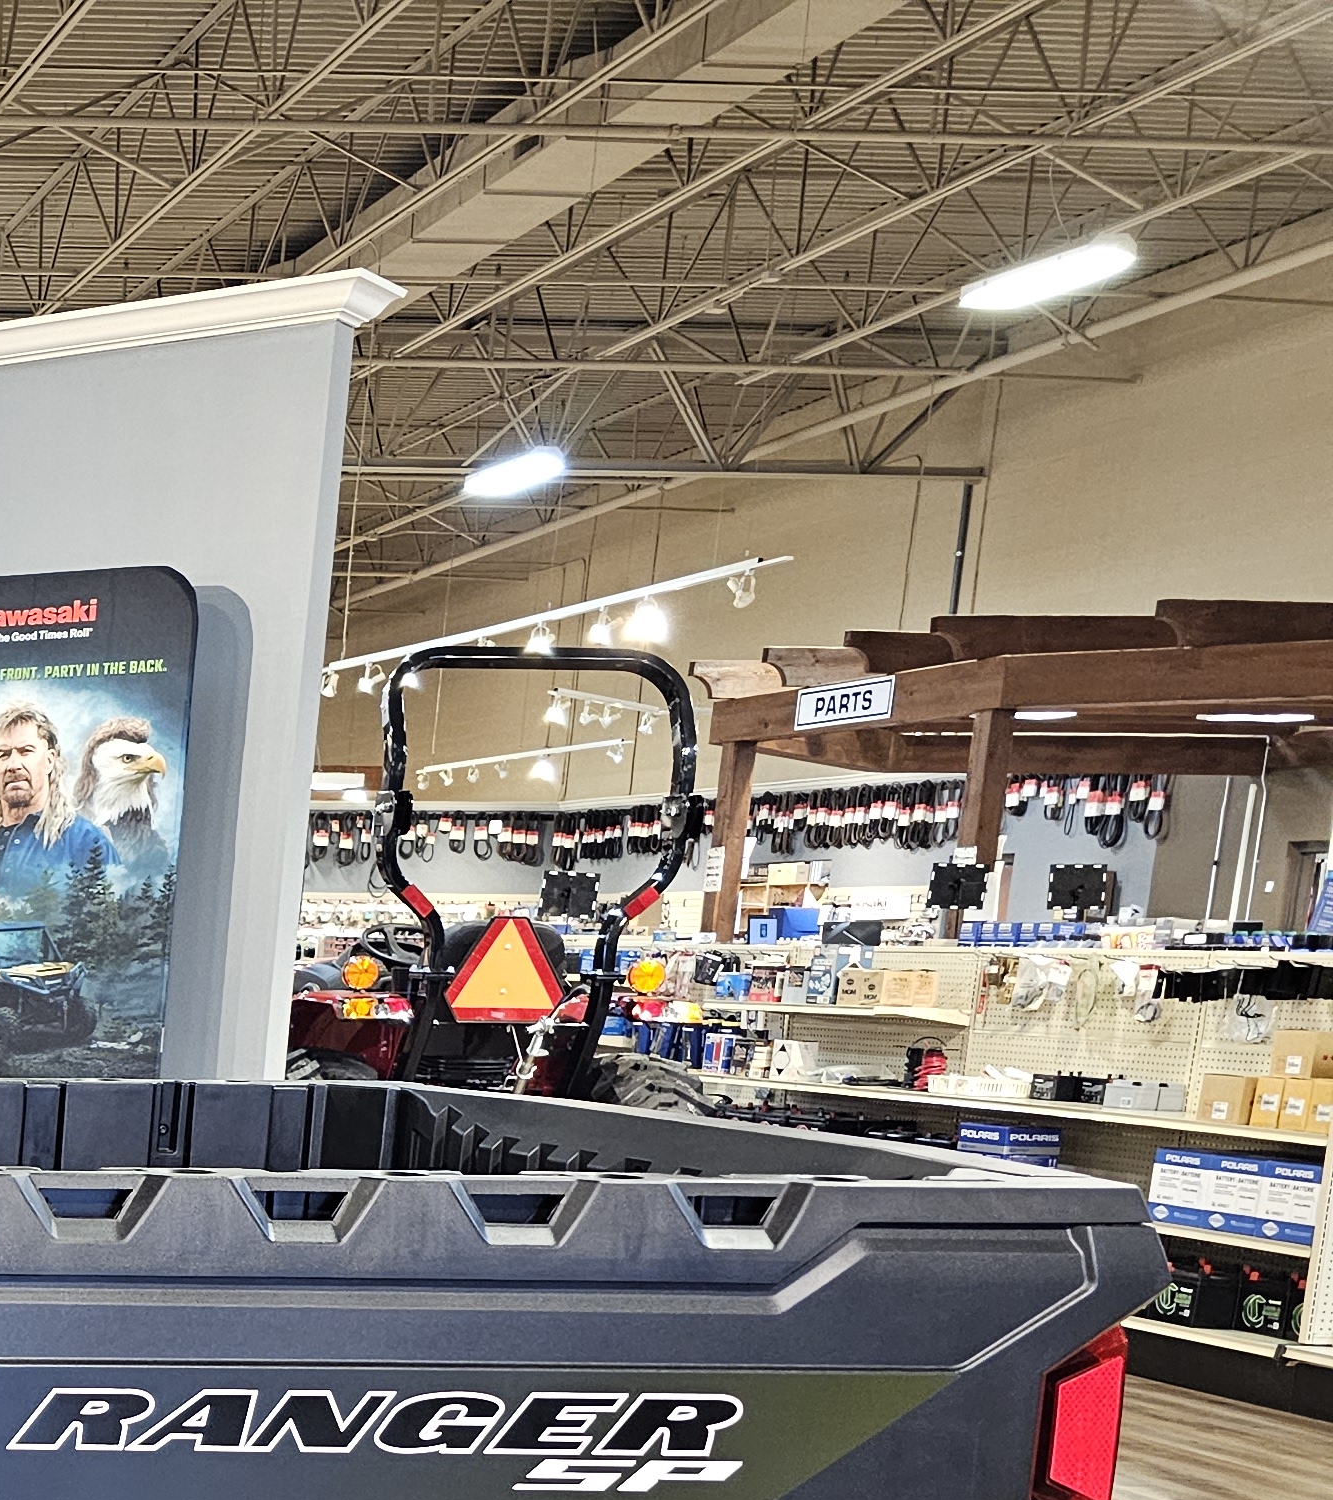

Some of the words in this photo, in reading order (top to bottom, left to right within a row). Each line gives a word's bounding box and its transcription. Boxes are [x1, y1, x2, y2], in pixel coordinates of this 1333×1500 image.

[11, 630, 37, 642] Good
[38, 629, 68, 641] Times
[69, 627, 90, 639] Roll
[0, 666, 41, 682] FRONT.
[44, 663, 83, 679] PARTY
[86, 662, 100, 676] IN
[102, 660, 126, 675] THE
[129, 658, 168, 674] BACK.
[813, 690, 874, 718] PARTS
[960, 1128, 1000, 1141] POLARIS
[1009, 1132, 1060, 1142] POLARIS
[1165, 1153, 1201, 1166] POLARIS
[1220, 1160, 1259, 1172] POLARIS
[1274, 1166, 1315, 1180] POLARIS
[6, 1387, 744, 1458] RANGER
[511, 1458, 744, 1492] SP
